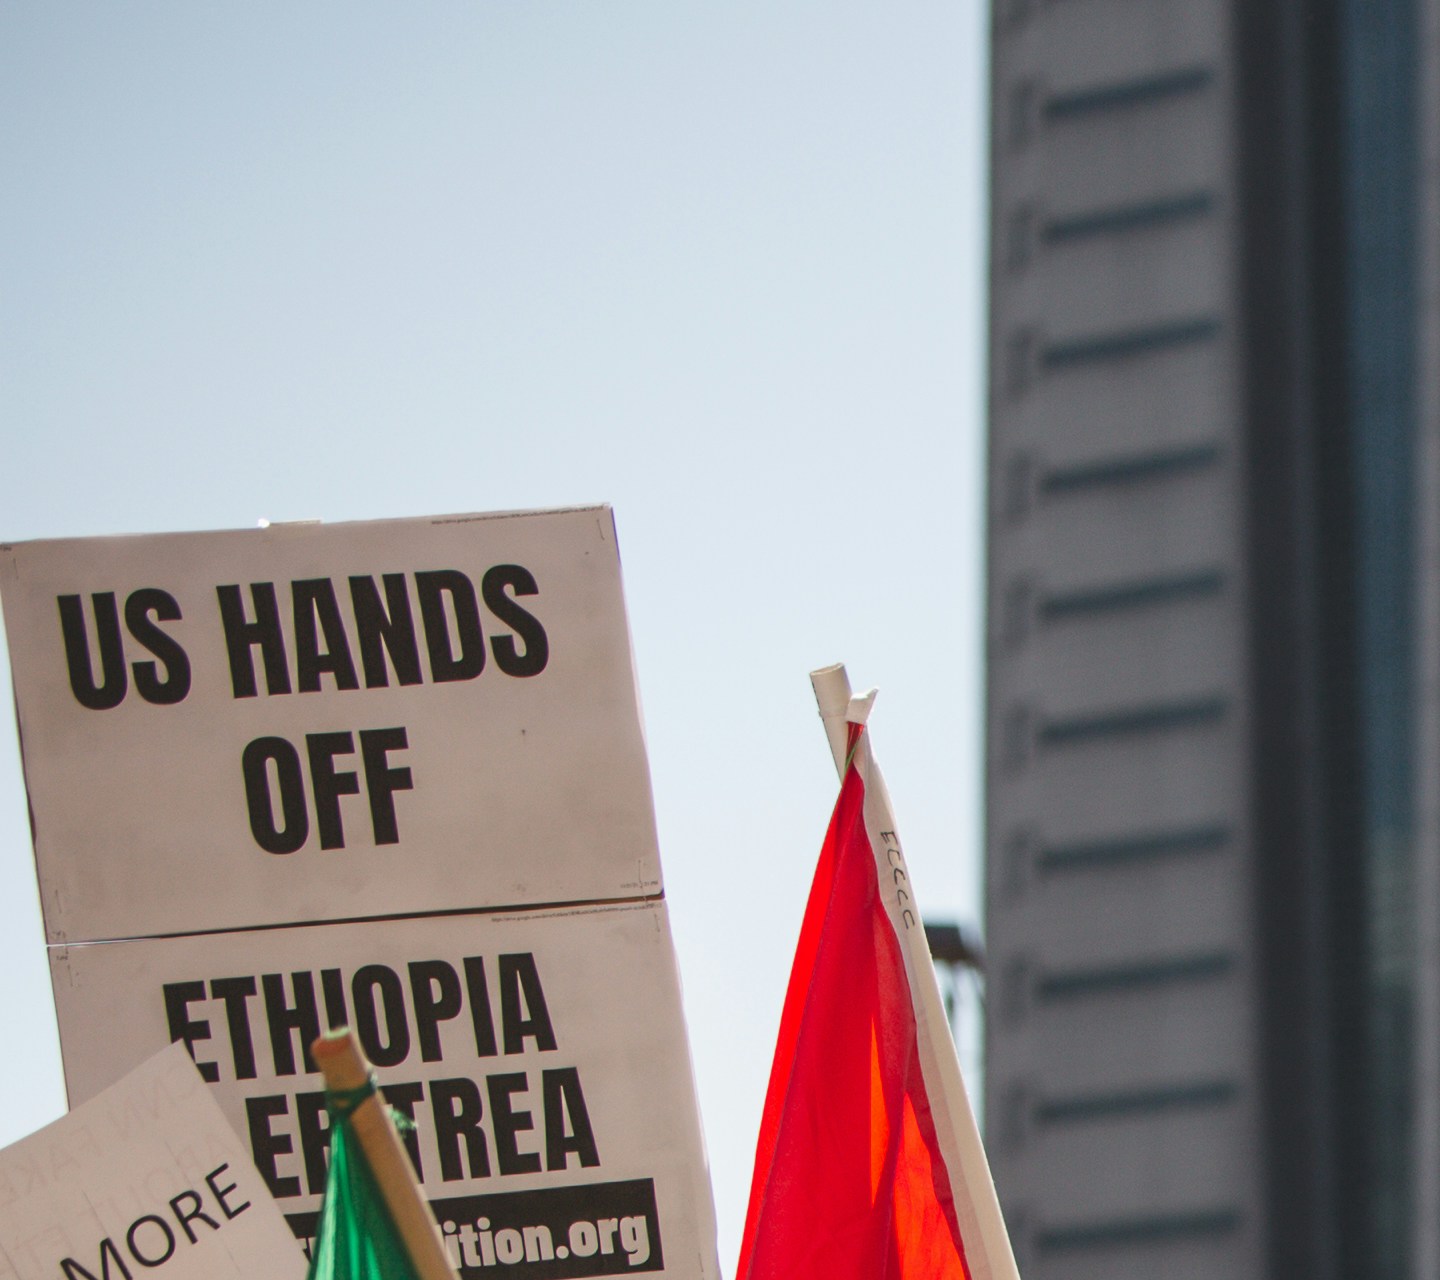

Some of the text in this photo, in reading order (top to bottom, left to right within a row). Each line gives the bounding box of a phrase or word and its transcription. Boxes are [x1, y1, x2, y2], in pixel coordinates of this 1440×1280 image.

[57, 564, 549, 710] US HANDS
[242, 727, 414, 854] OFF
[163, 952, 558, 1083] ETHIOPIA
[245, 1067, 601, 1198] ERTREA
[435, 1215, 651, 1270] ition.org
